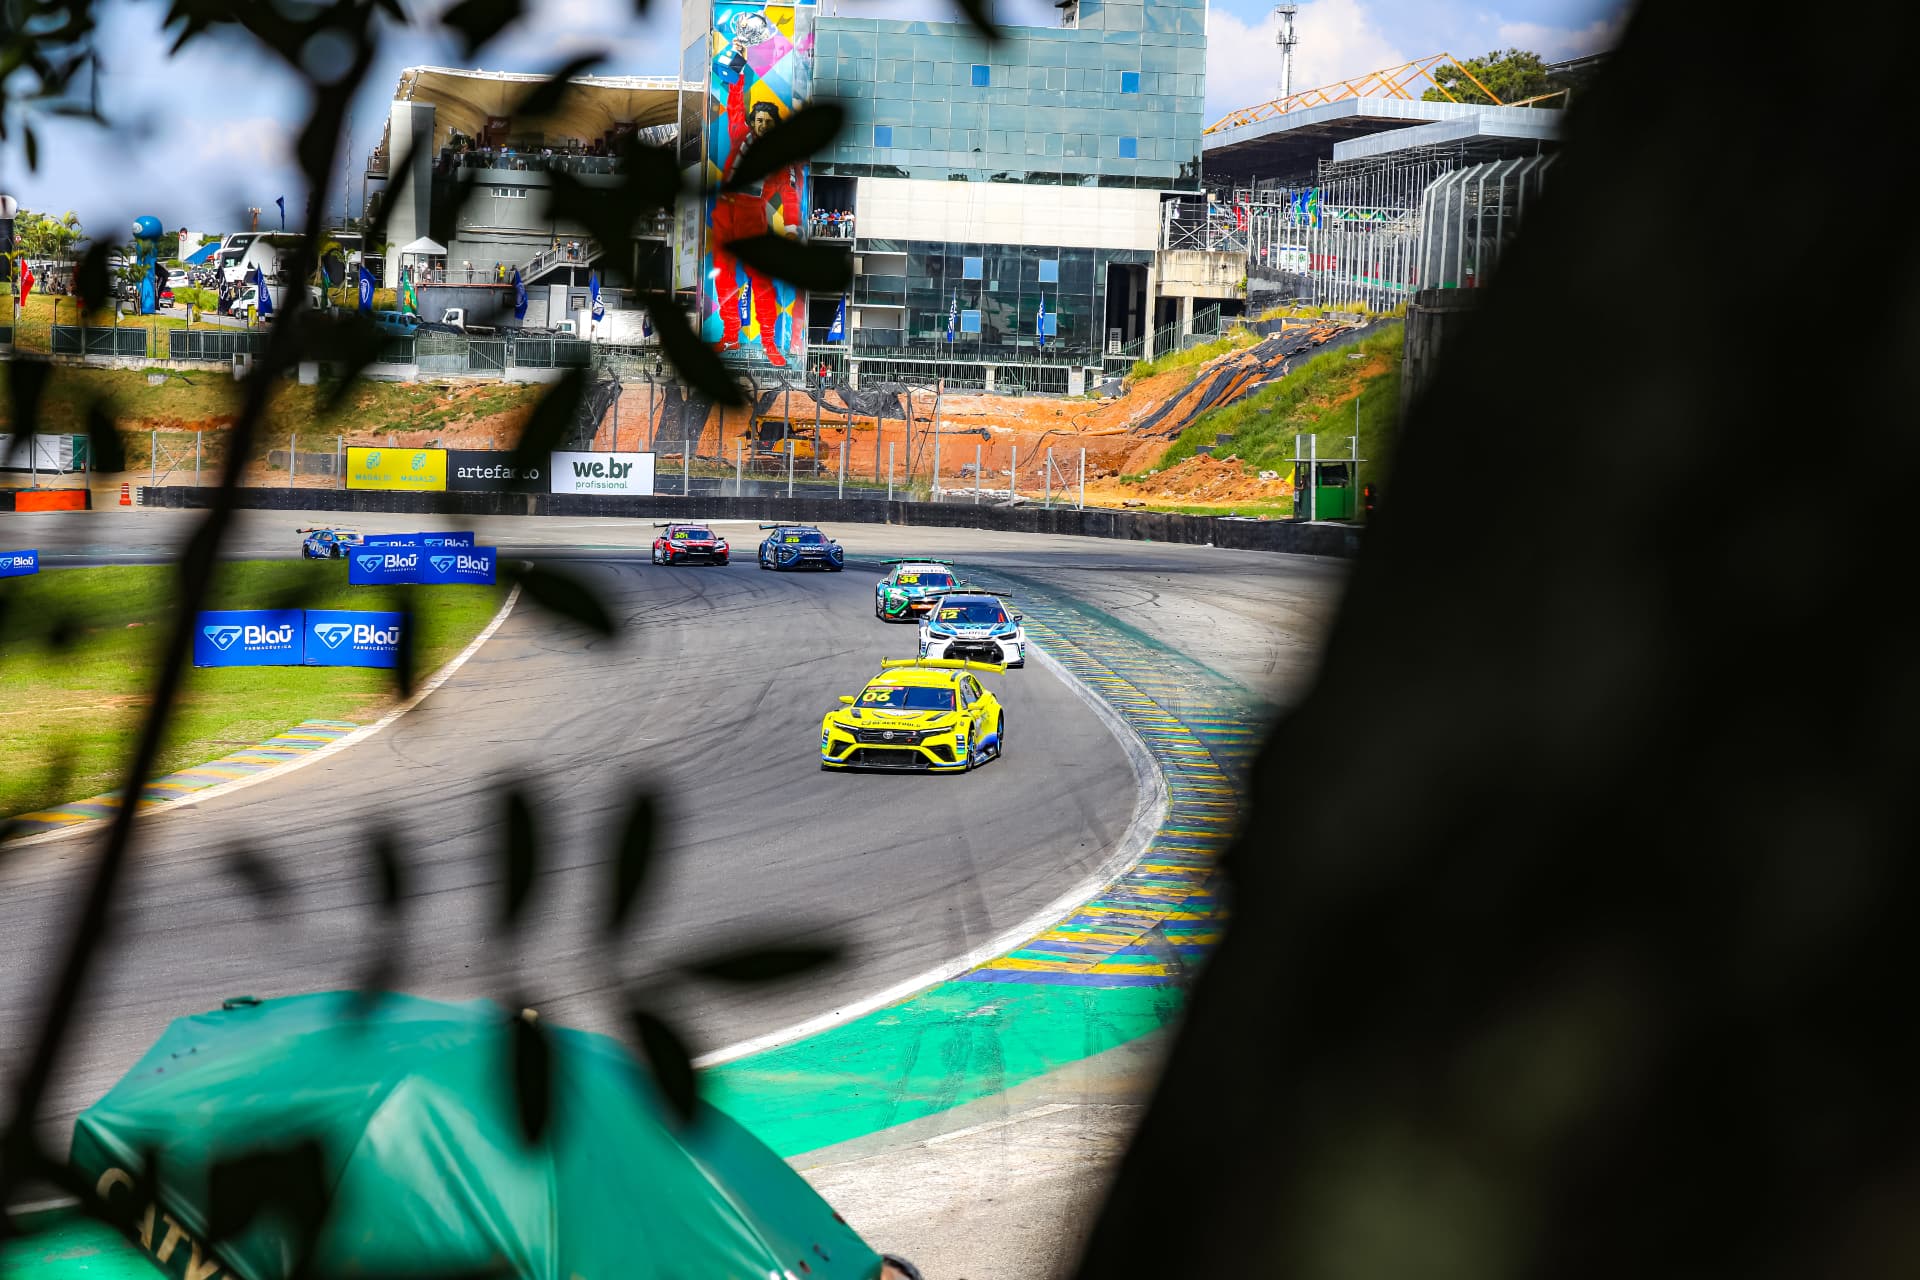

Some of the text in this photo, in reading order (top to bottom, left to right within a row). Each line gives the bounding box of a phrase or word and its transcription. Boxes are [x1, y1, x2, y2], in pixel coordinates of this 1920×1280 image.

[457, 465, 540, 479] artefao
[573, 457, 633, 478] we.br
[576, 481, 628, 490] profissional
[941, 611, 958, 620] 12
[862, 692, 890, 702] 06
